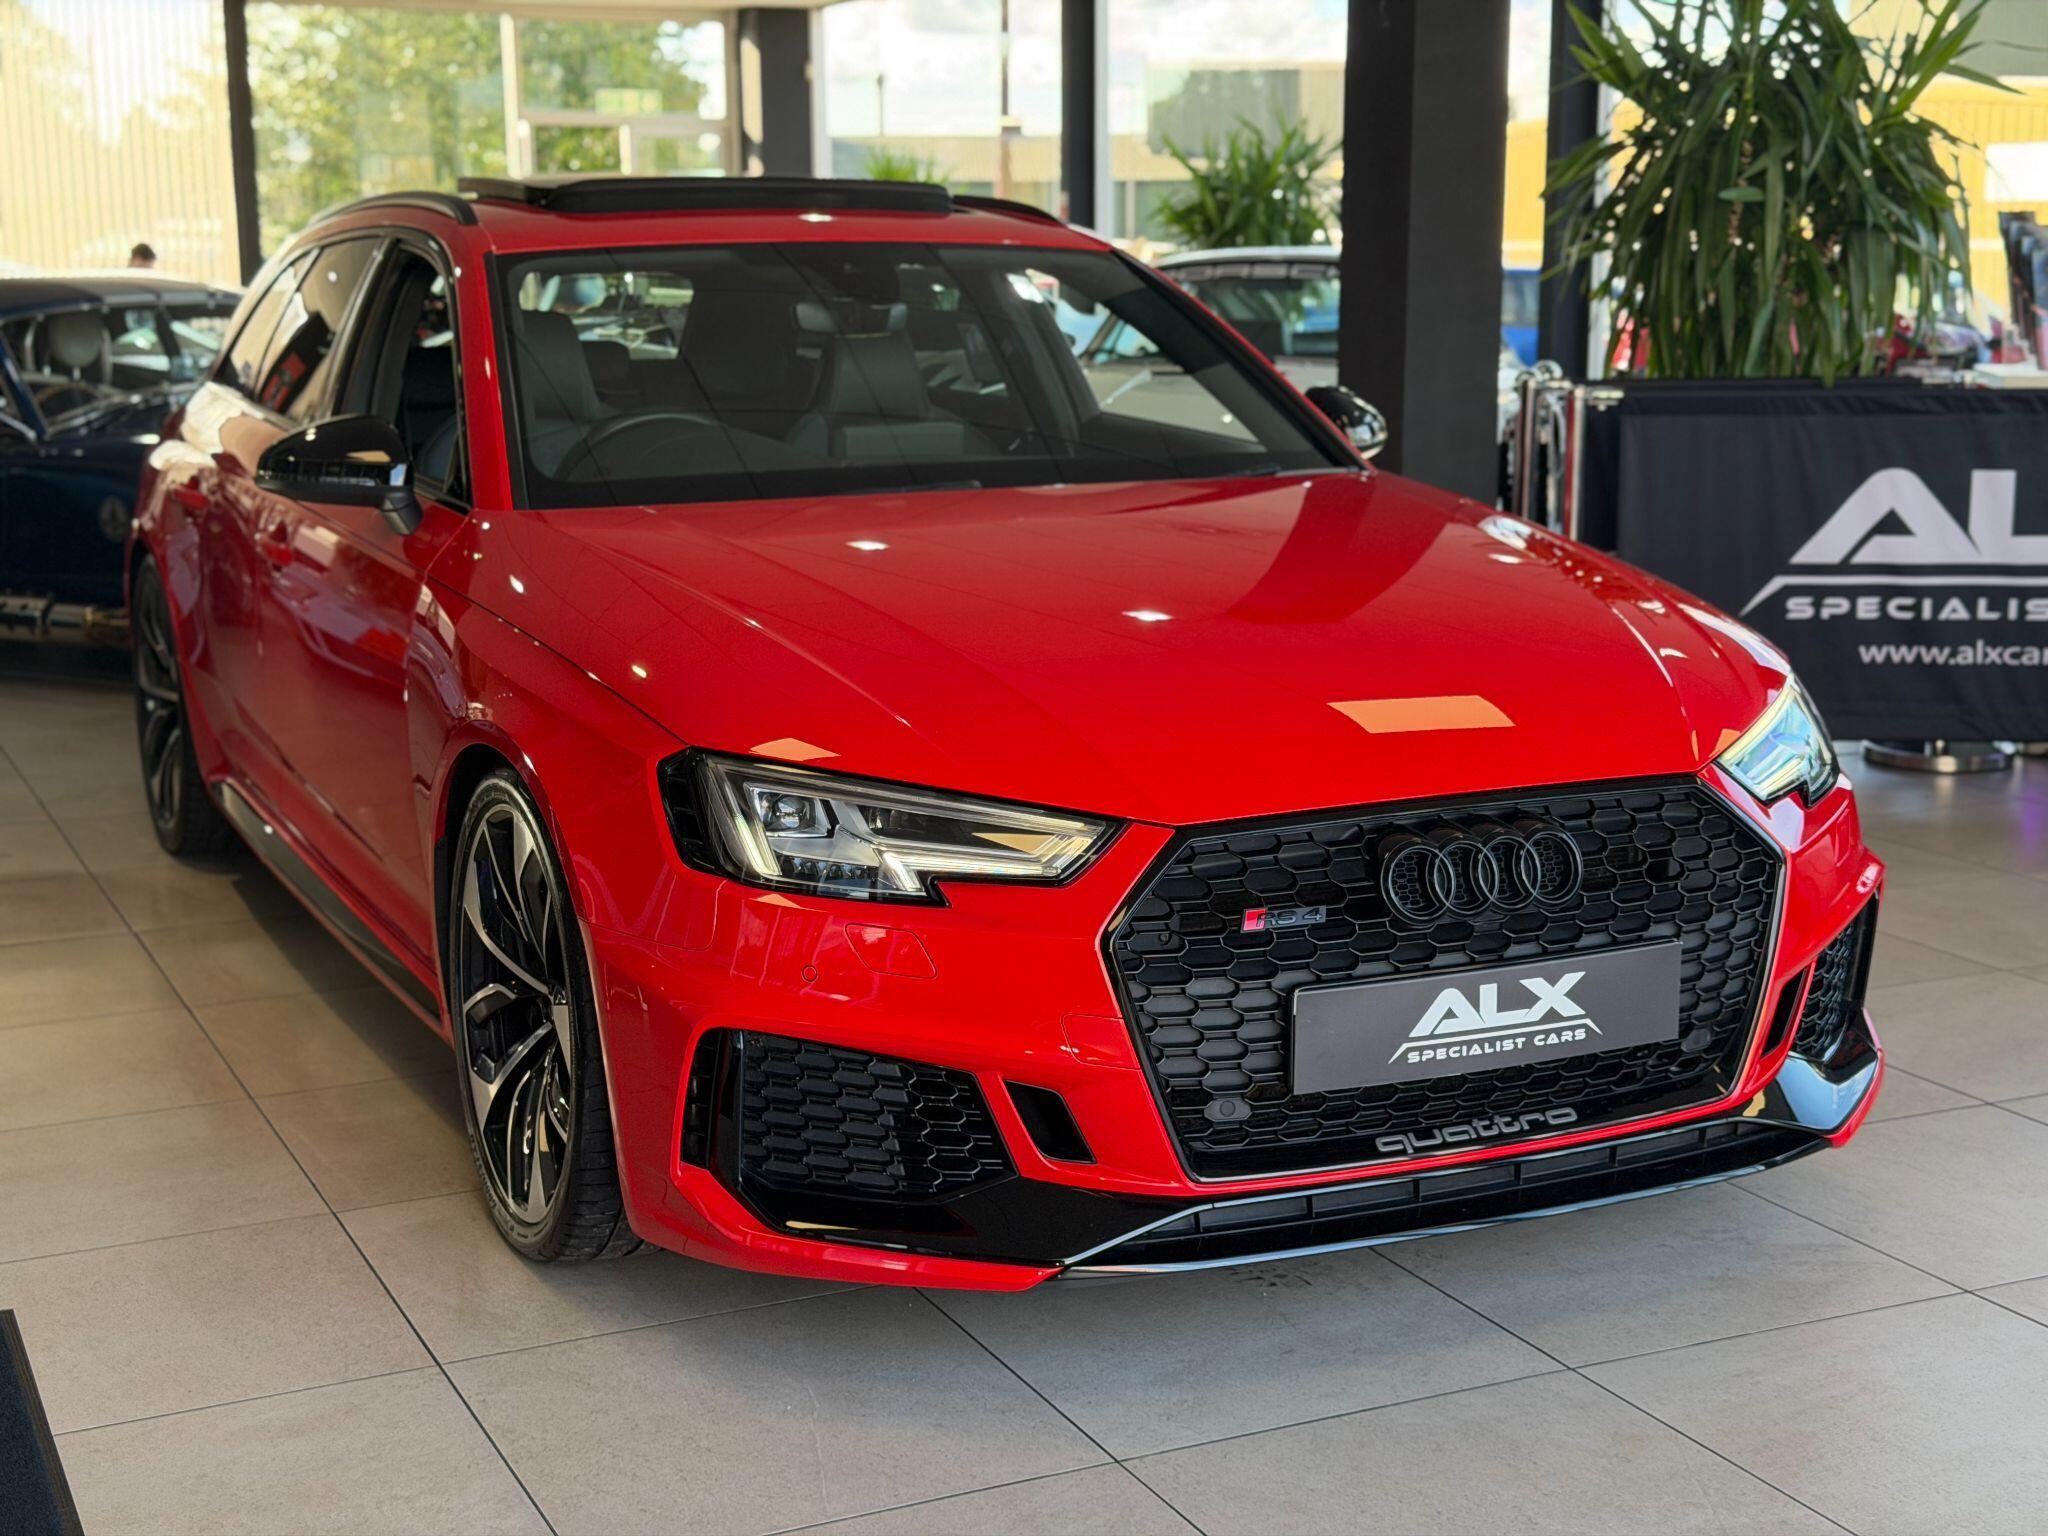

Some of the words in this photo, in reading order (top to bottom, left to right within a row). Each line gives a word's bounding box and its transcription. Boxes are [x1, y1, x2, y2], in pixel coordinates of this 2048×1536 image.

[1408, 971, 1587, 1038] ALX
[1407, 1037, 1526, 1064] SPECIALIST
[1533, 1028, 1587, 1046] CARS
[1375, 1106, 1578, 1154] quattro
